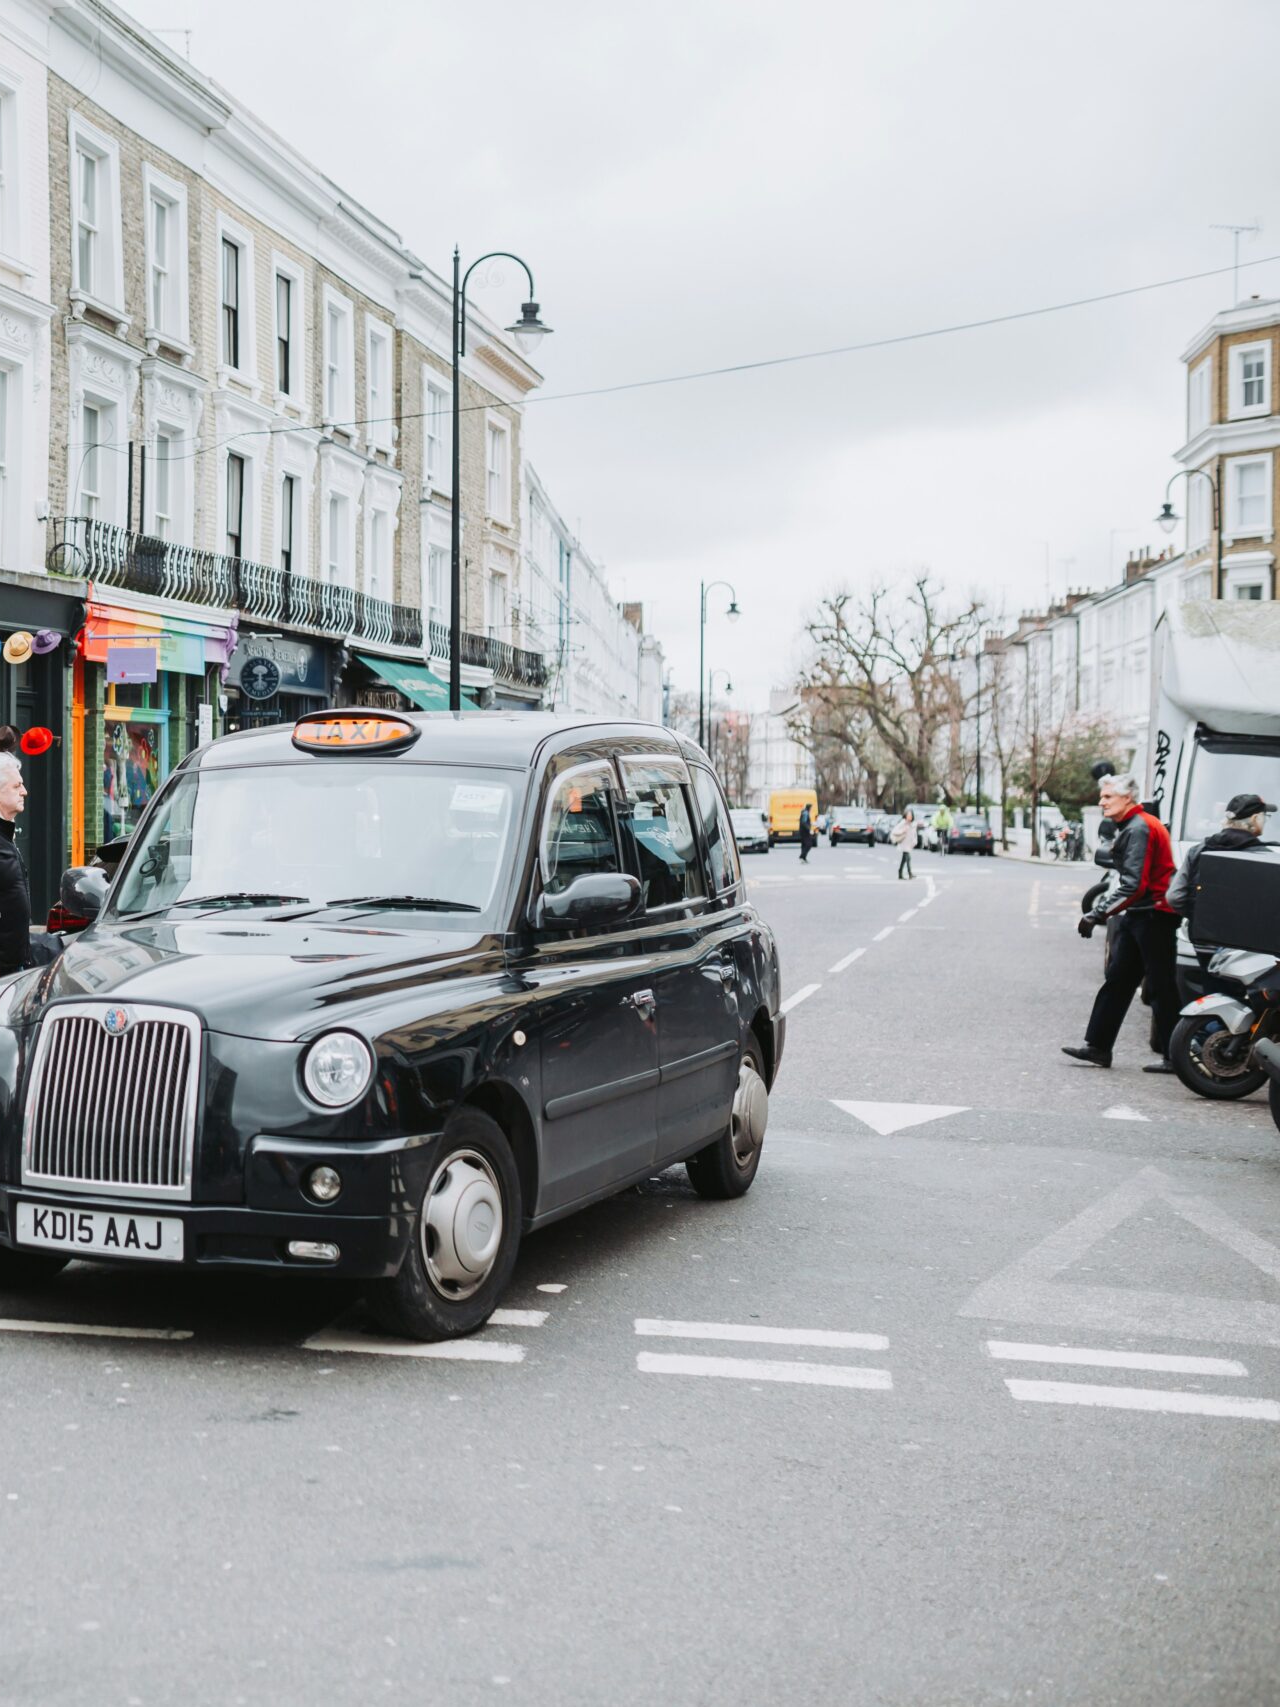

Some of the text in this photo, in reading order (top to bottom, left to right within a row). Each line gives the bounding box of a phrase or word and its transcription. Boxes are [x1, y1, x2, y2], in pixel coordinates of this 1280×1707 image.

[313, 721, 382, 740] TAXI
[33, 1208, 162, 1251] KD15 AAJ
